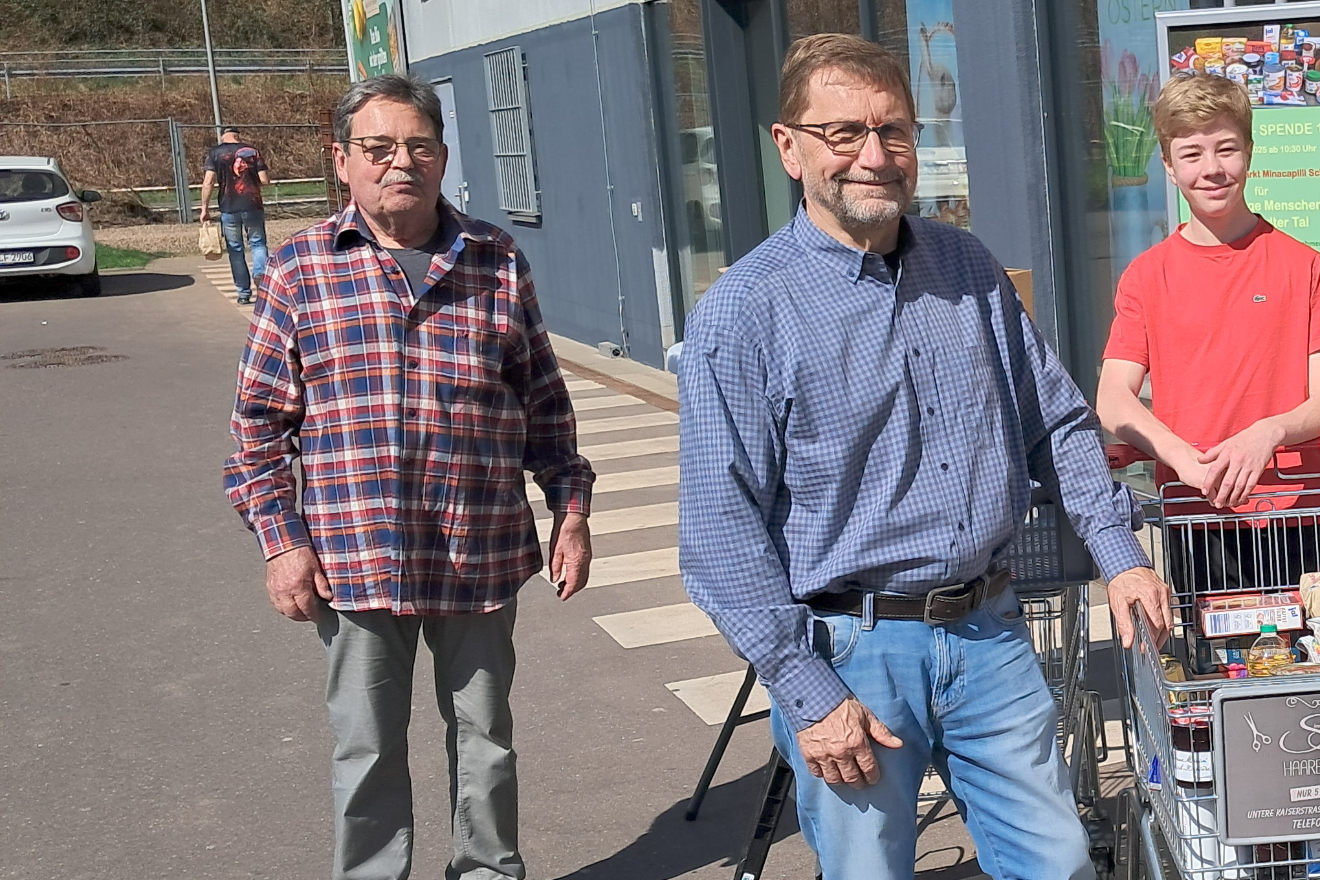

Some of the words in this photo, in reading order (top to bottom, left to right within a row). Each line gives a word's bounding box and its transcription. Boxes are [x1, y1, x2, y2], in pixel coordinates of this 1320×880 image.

[1259, 122, 1313, 136] SPENDE
[1253, 146, 1267, 154] 025
[1268, 146, 1278, 154] ab
[1280, 145, 1300, 153] 10:30
[1262, 169, 1306, 179] Minacapilli
[1254, 186, 1269, 196] für
[1291, 216, 1310, 228] Tal
[1296, 789, 1312, 799] NUR
[1314, 787, 1319, 796] 5
[1246, 808, 1275, 819] UNTERE
